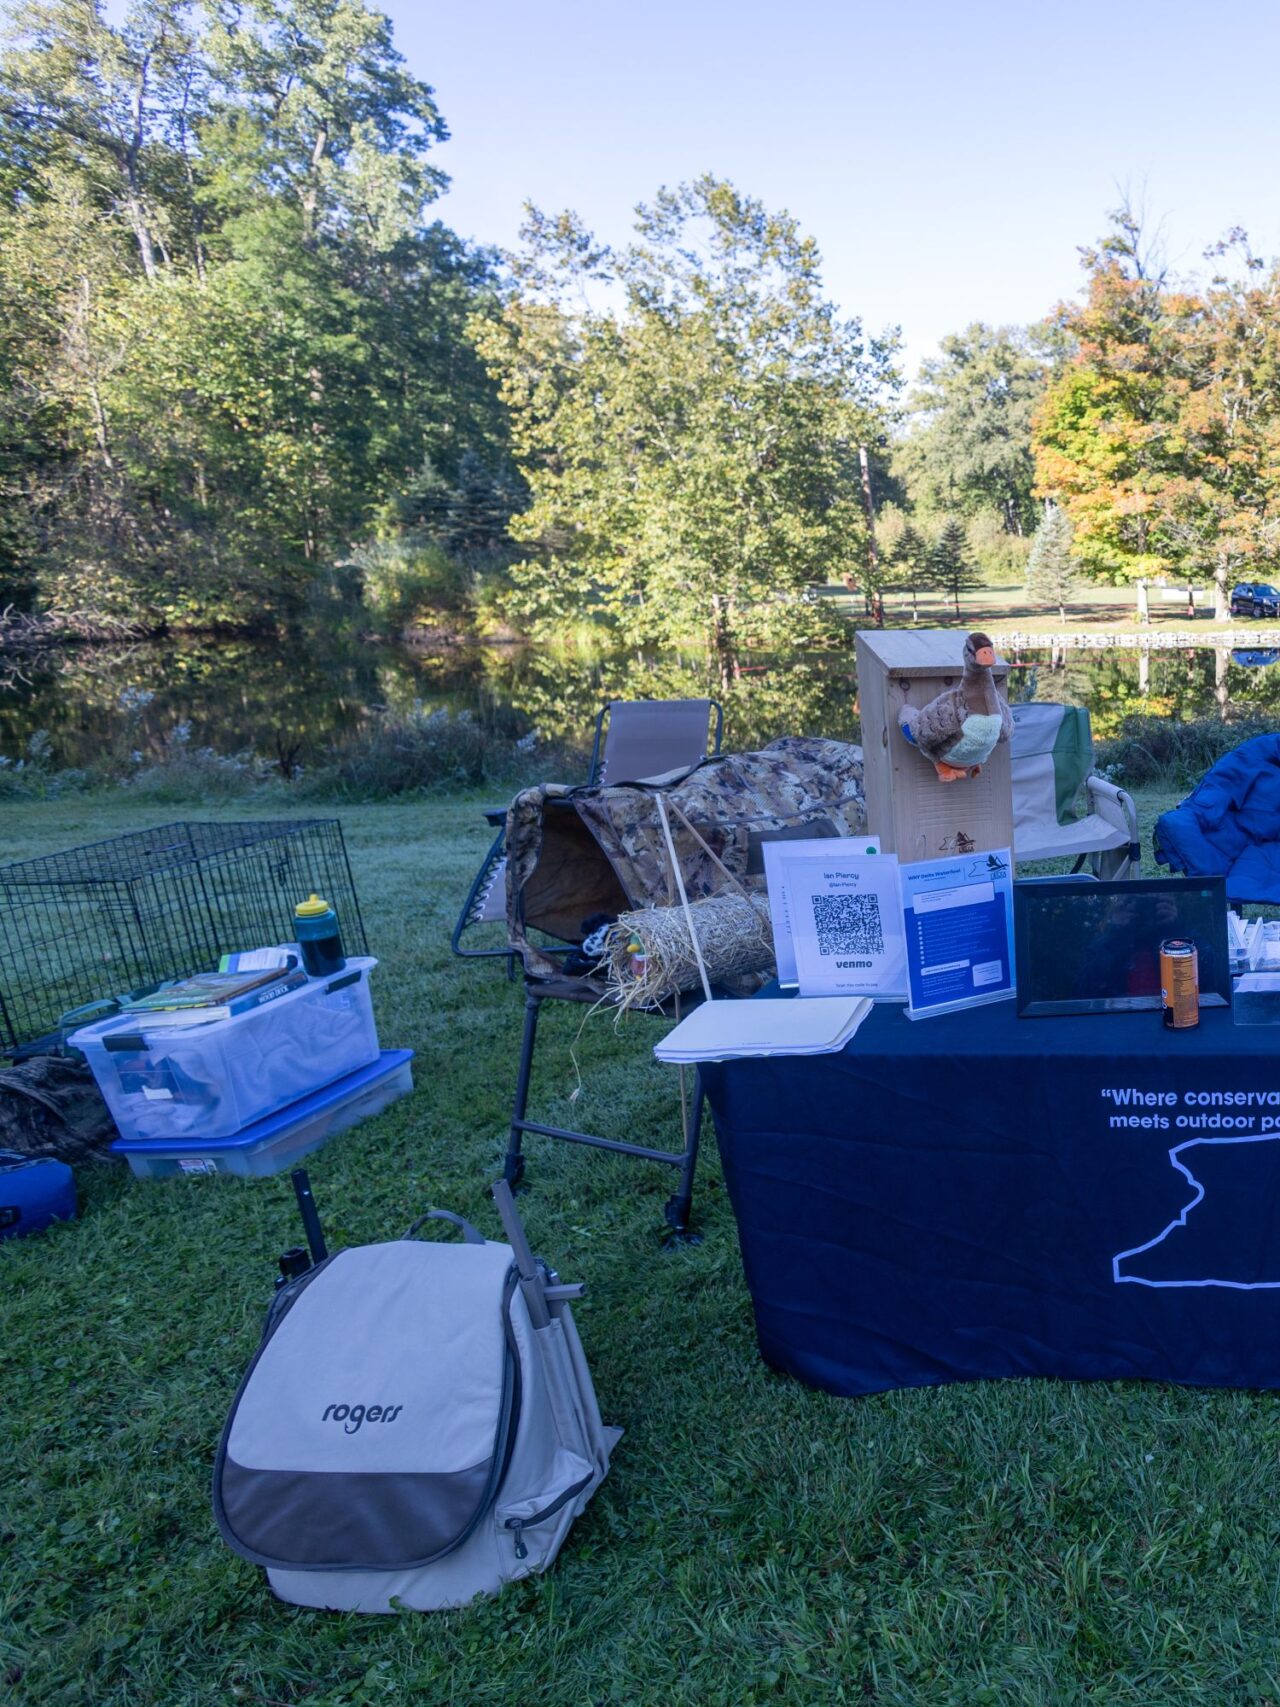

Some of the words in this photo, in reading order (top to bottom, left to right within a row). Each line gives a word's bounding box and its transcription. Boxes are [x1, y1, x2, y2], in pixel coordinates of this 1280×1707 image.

[836, 960, 873, 969] venmo
[1109, 1114, 1170, 1129] meets
[1175, 1113, 1255, 1128] outdoor
[322, 1404, 403, 1435] rogers
